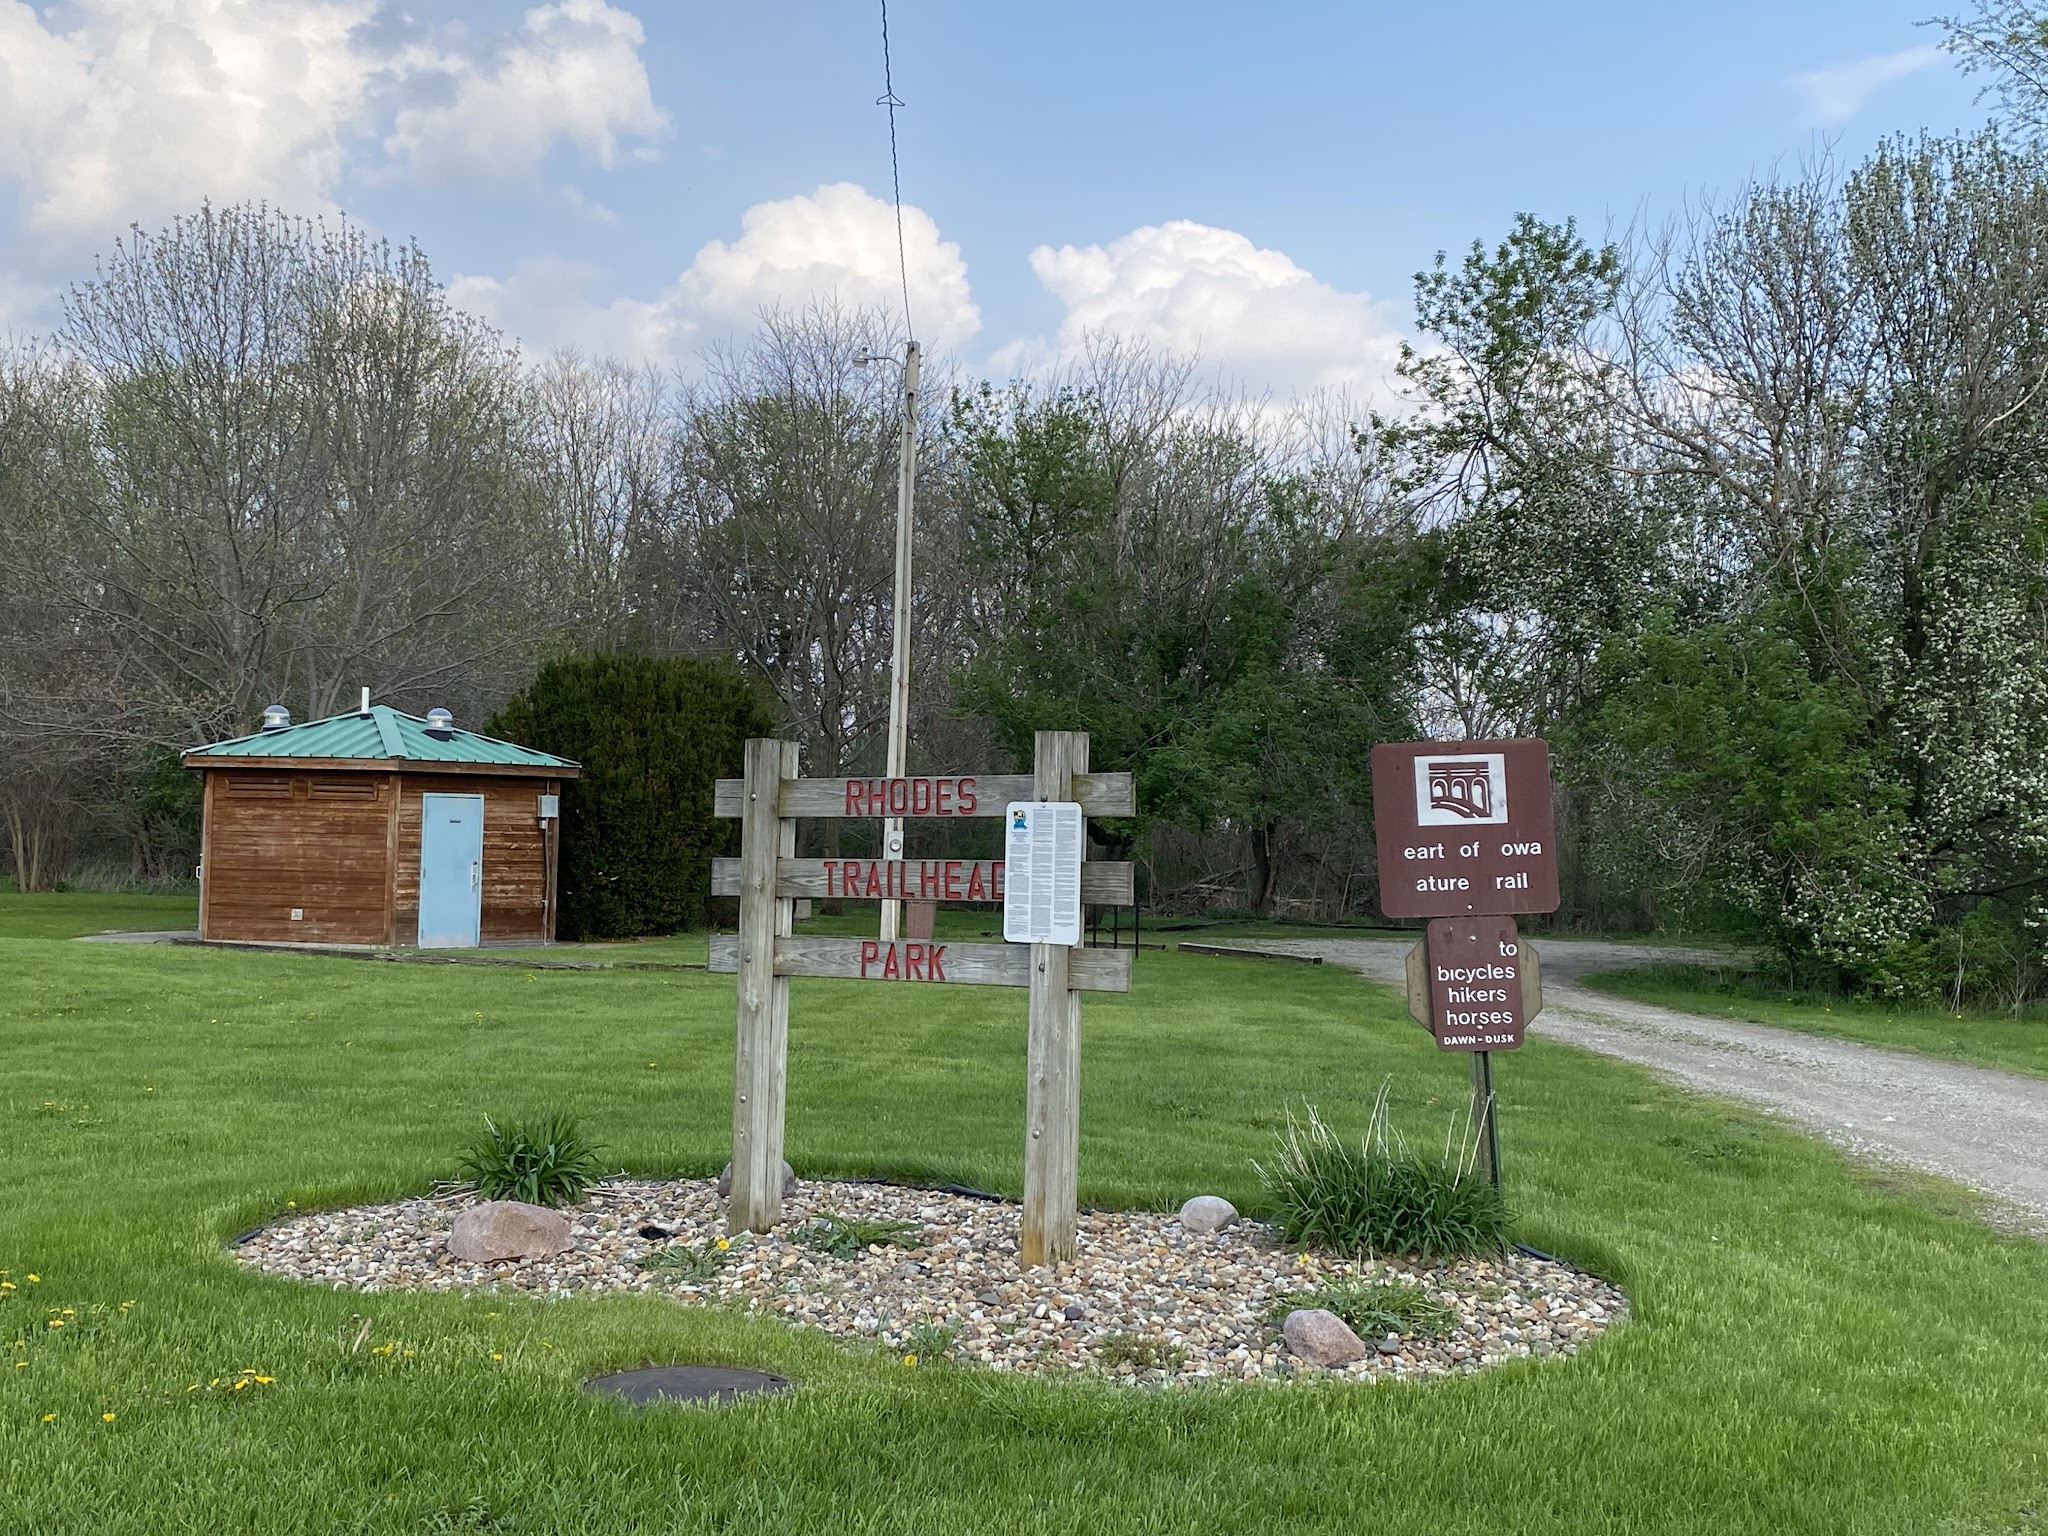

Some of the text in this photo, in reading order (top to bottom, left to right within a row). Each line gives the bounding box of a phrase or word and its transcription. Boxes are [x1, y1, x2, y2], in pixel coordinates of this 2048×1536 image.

[846, 777, 977, 816] RHODES
[1459, 841, 1480, 858] of
[824, 861, 1004, 900] TRAILHEAD
[1495, 872, 1528, 890] rail
[1498, 940, 1518, 957] to
[861, 941, 945, 981] PARK
[1437, 963, 1516, 984] bicycles
[1447, 986, 1507, 1004] hikers
[1446, 1009, 1513, 1026] horses
